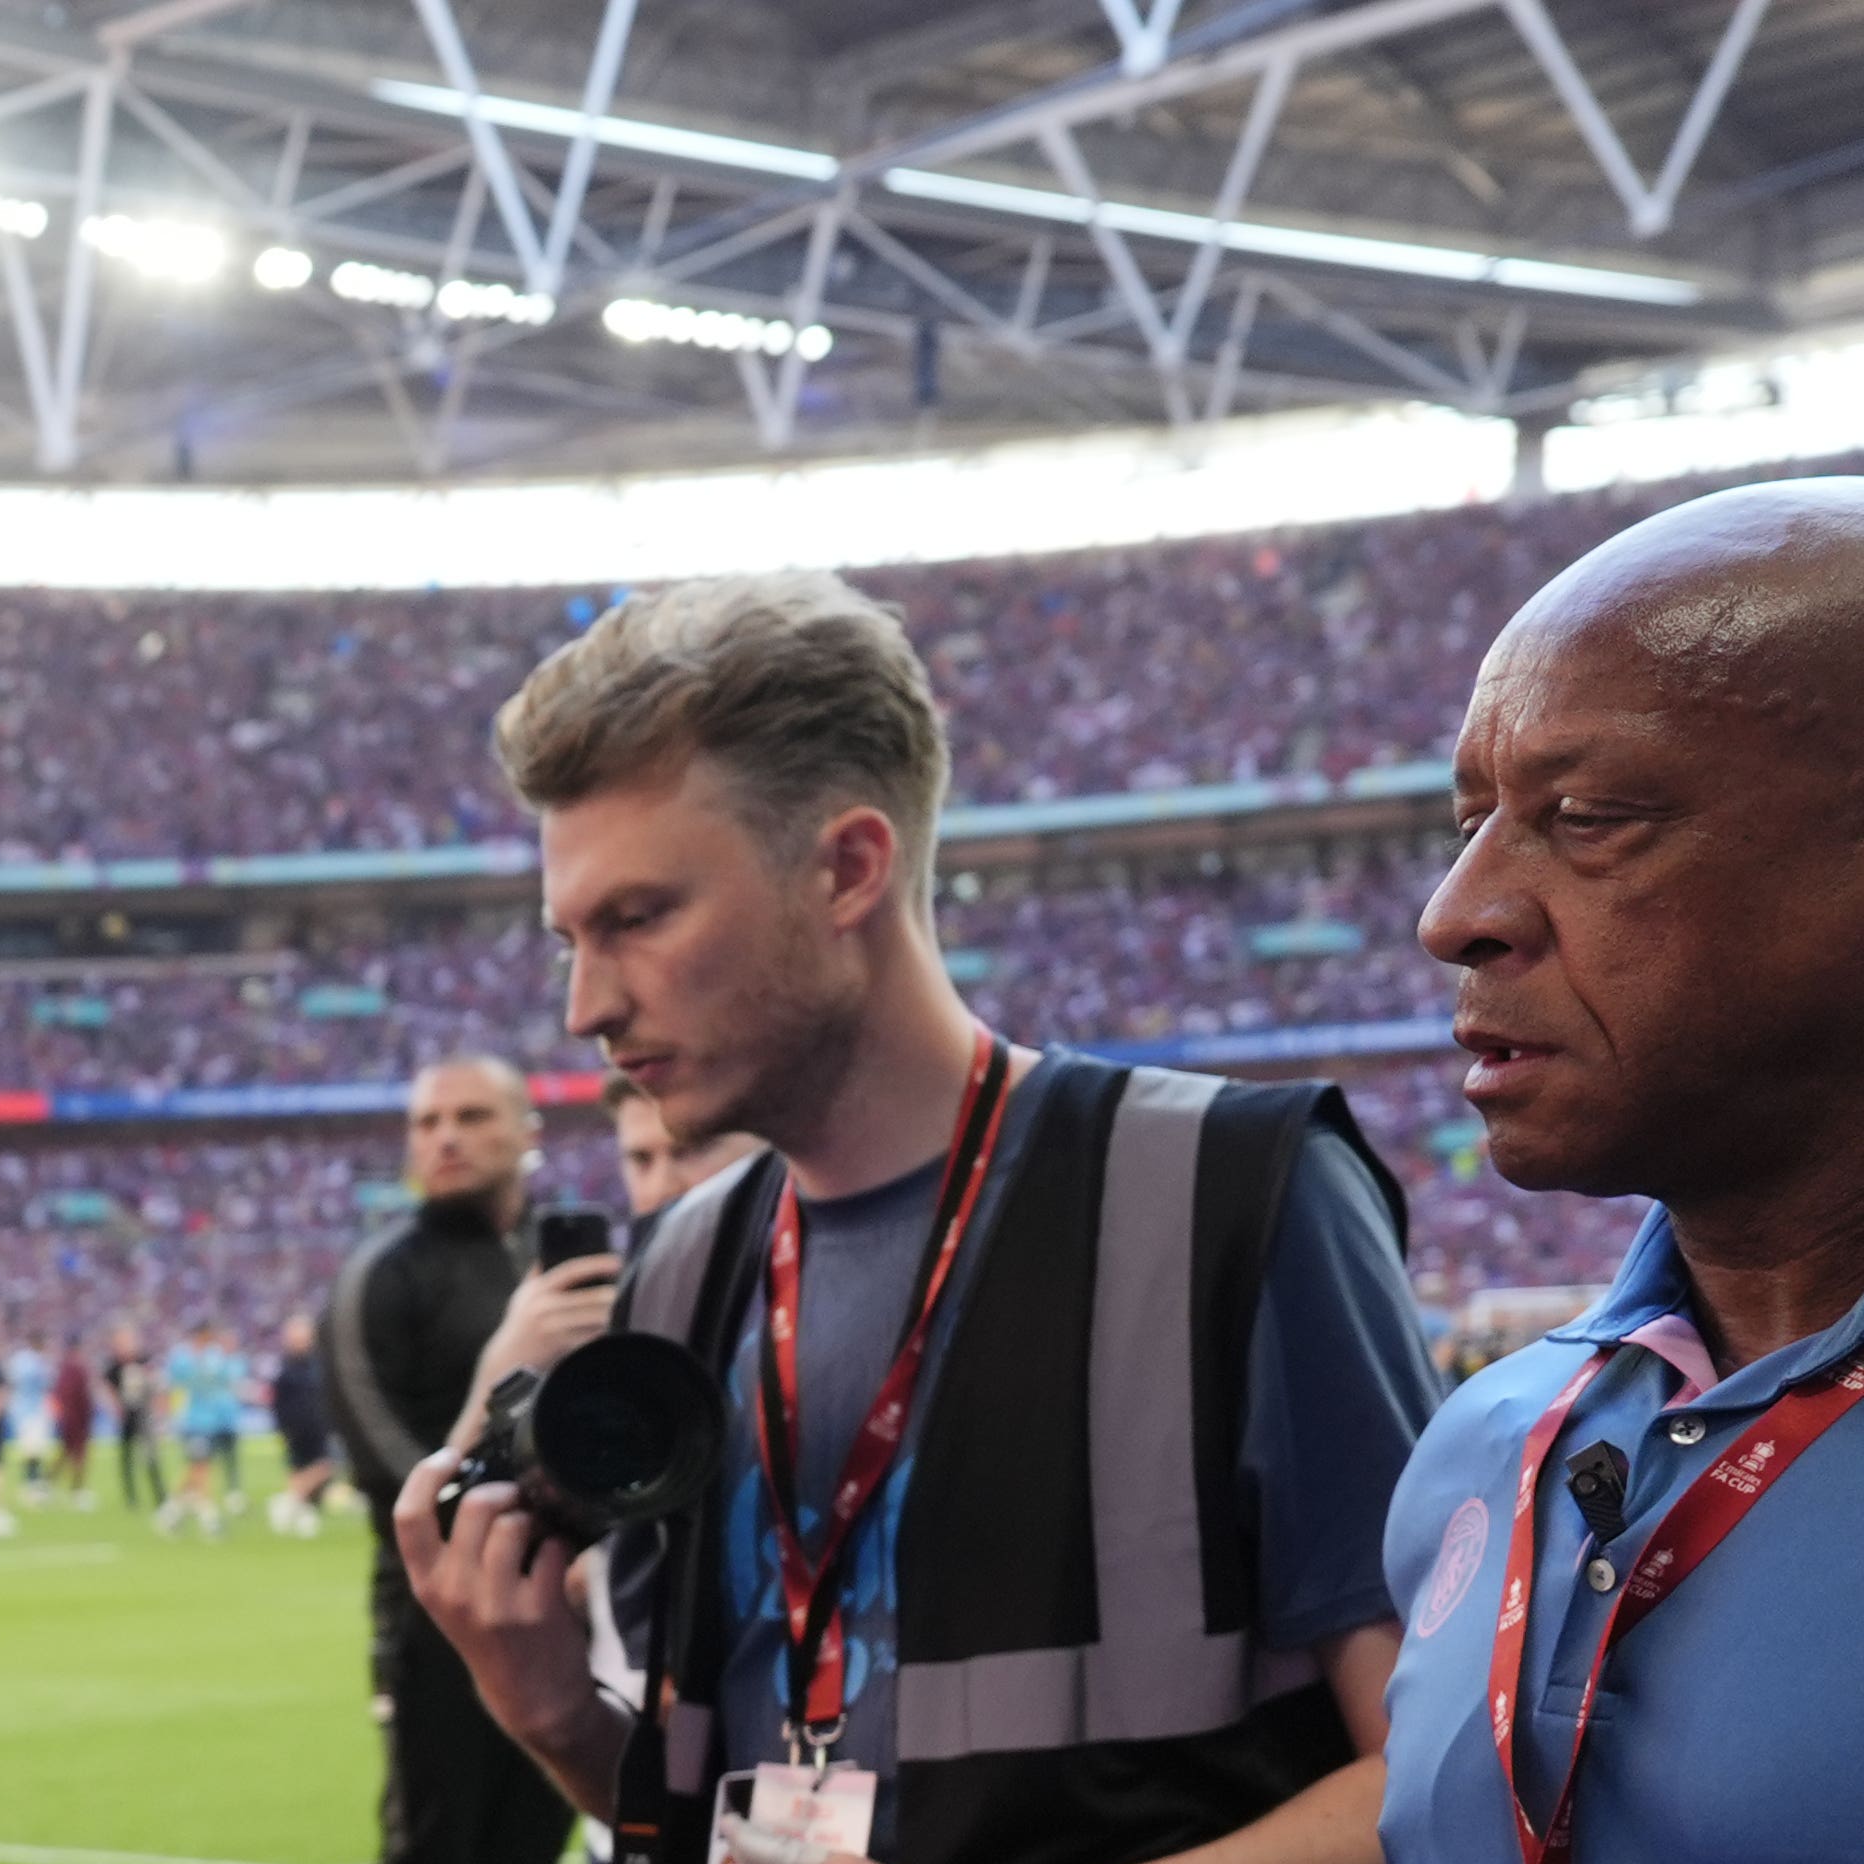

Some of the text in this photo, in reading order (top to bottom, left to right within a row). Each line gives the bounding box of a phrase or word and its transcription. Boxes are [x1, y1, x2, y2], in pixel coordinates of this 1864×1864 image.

[1709, 1469, 1757, 1495] FA CUP
[1719, 1461, 1762, 1487] Emirates
